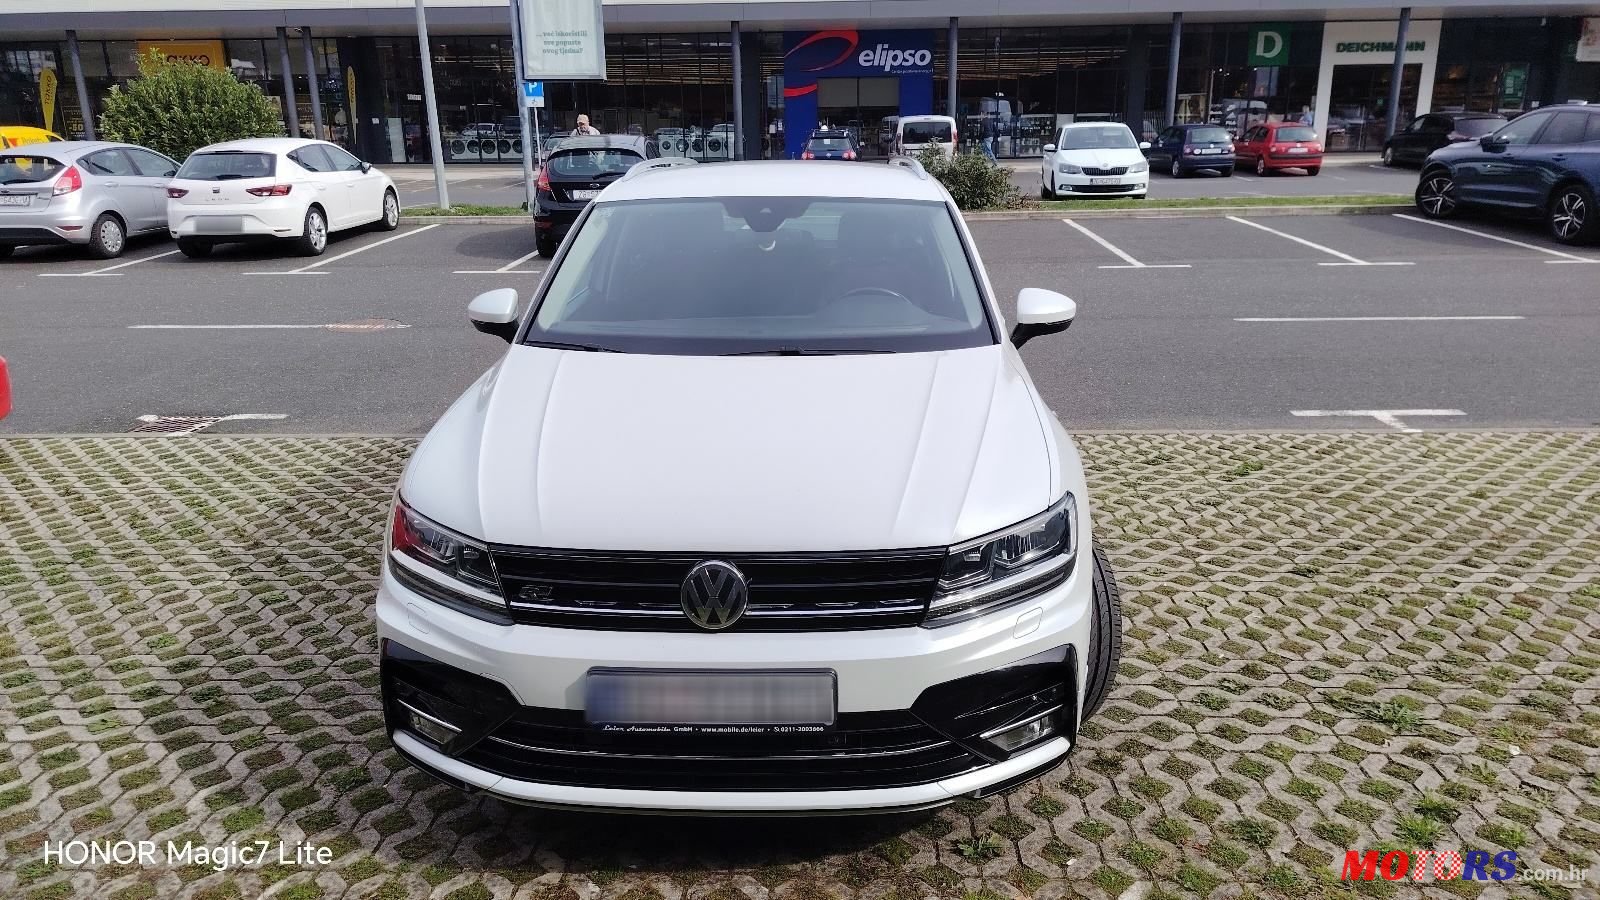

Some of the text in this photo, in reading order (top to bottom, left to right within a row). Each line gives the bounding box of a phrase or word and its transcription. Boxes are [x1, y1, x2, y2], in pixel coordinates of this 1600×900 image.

[559, 47, 583, 55] tjedna?
[1255, 31, 1283, 58] D
[1336, 41, 1426, 53] DEICHMNN
[858, 43, 932, 72] elipso
